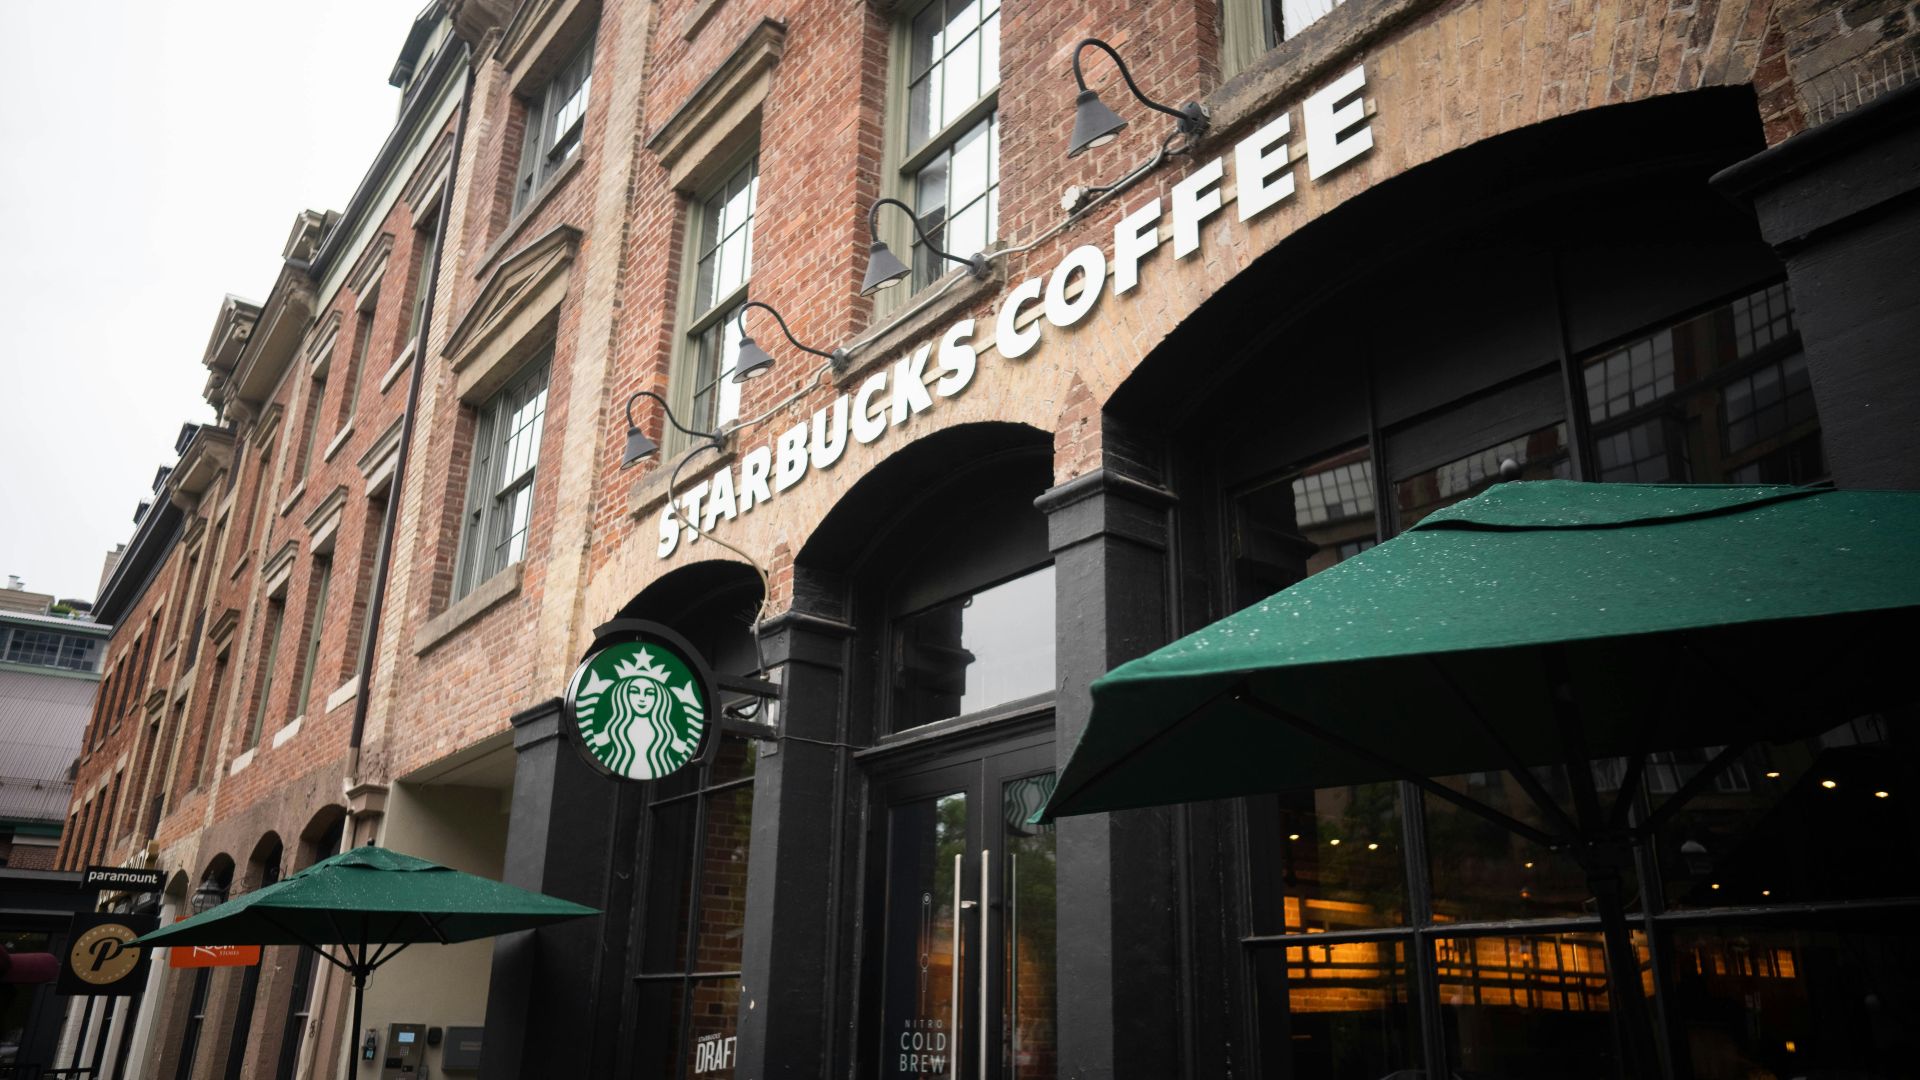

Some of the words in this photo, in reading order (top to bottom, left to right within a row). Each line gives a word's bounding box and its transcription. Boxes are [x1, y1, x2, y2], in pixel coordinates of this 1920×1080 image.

[657, 318, 977, 560] STARBUCKS
[996, 63, 1375, 360] COFFEE
[88, 870, 158, 884] paramount
[904, 1019, 943, 1029] NITRO
[900, 1031, 947, 1051] COLD
[899, 1053, 946, 1074] BREW
